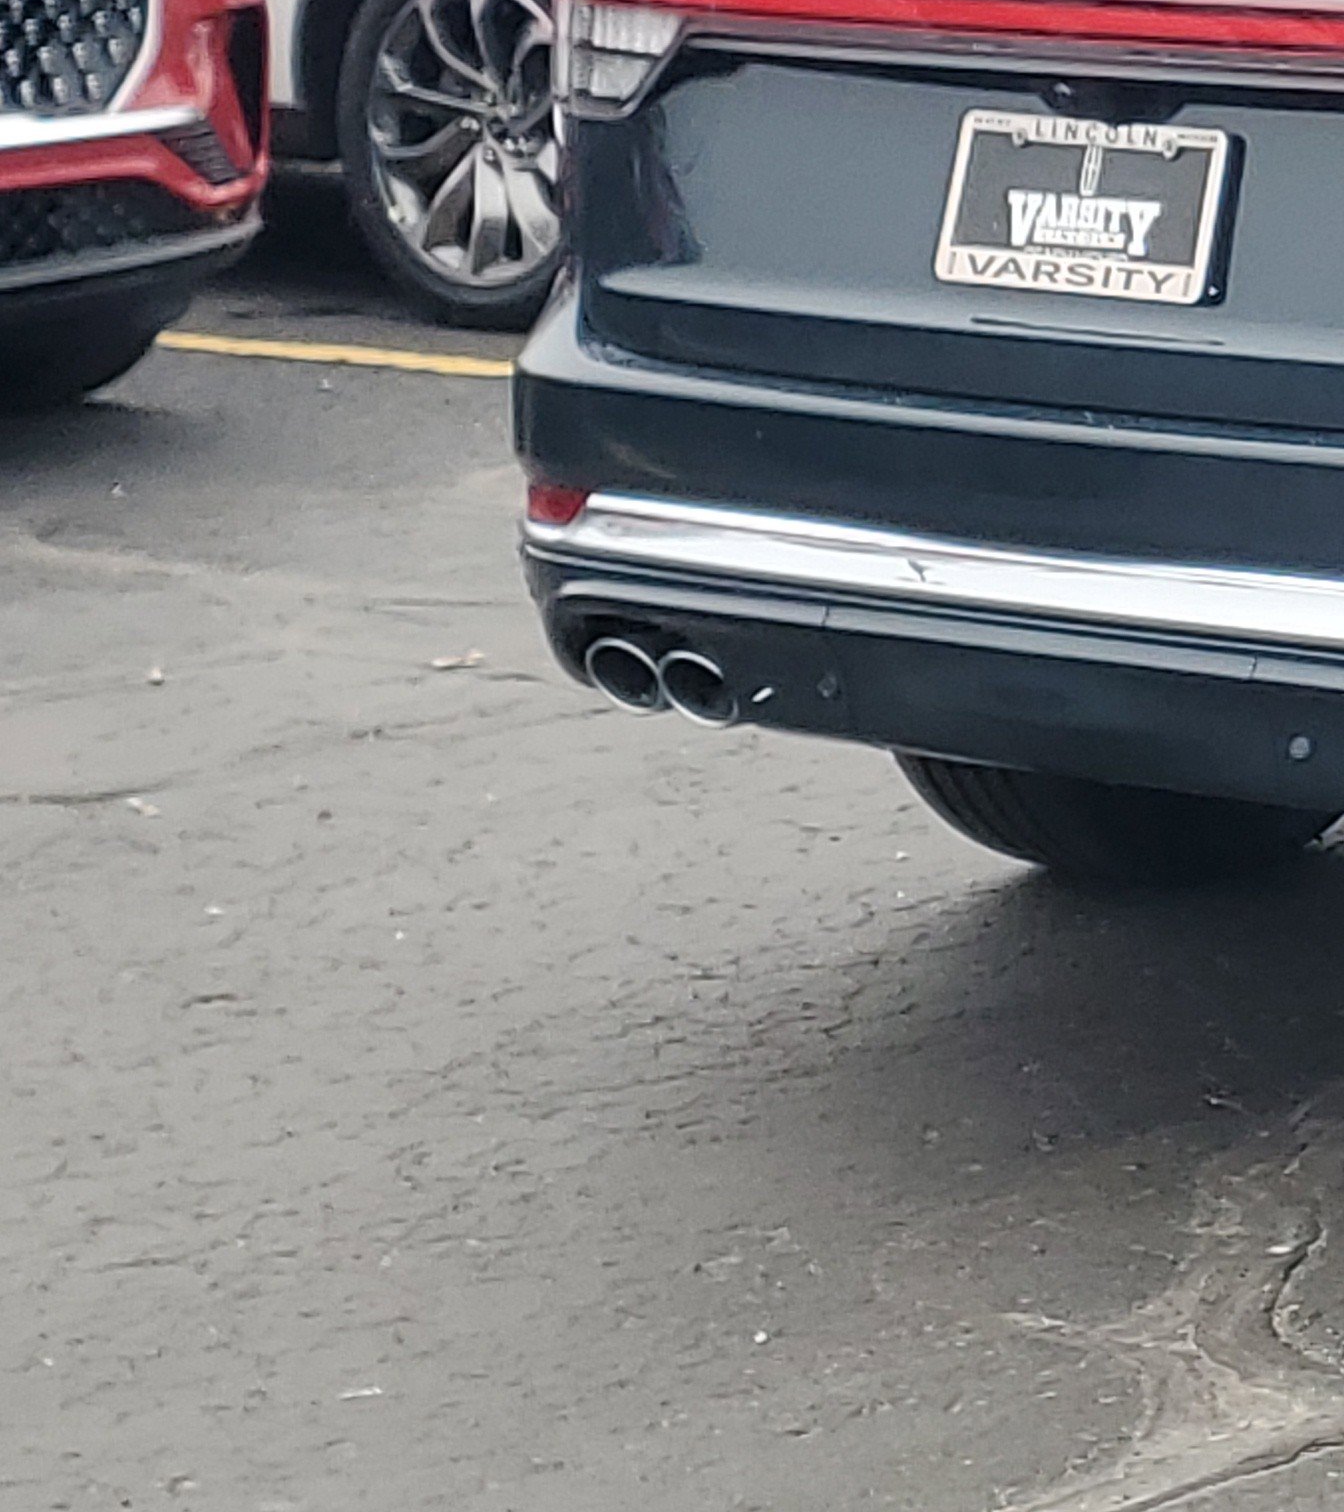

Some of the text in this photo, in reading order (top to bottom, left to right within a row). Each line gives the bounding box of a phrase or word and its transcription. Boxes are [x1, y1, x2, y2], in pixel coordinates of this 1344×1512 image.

[1034, 117, 1160, 147] LINCOLN
[1008, 189, 1161, 257] VARSITY
[967, 252, 1175, 295] VARSITY
